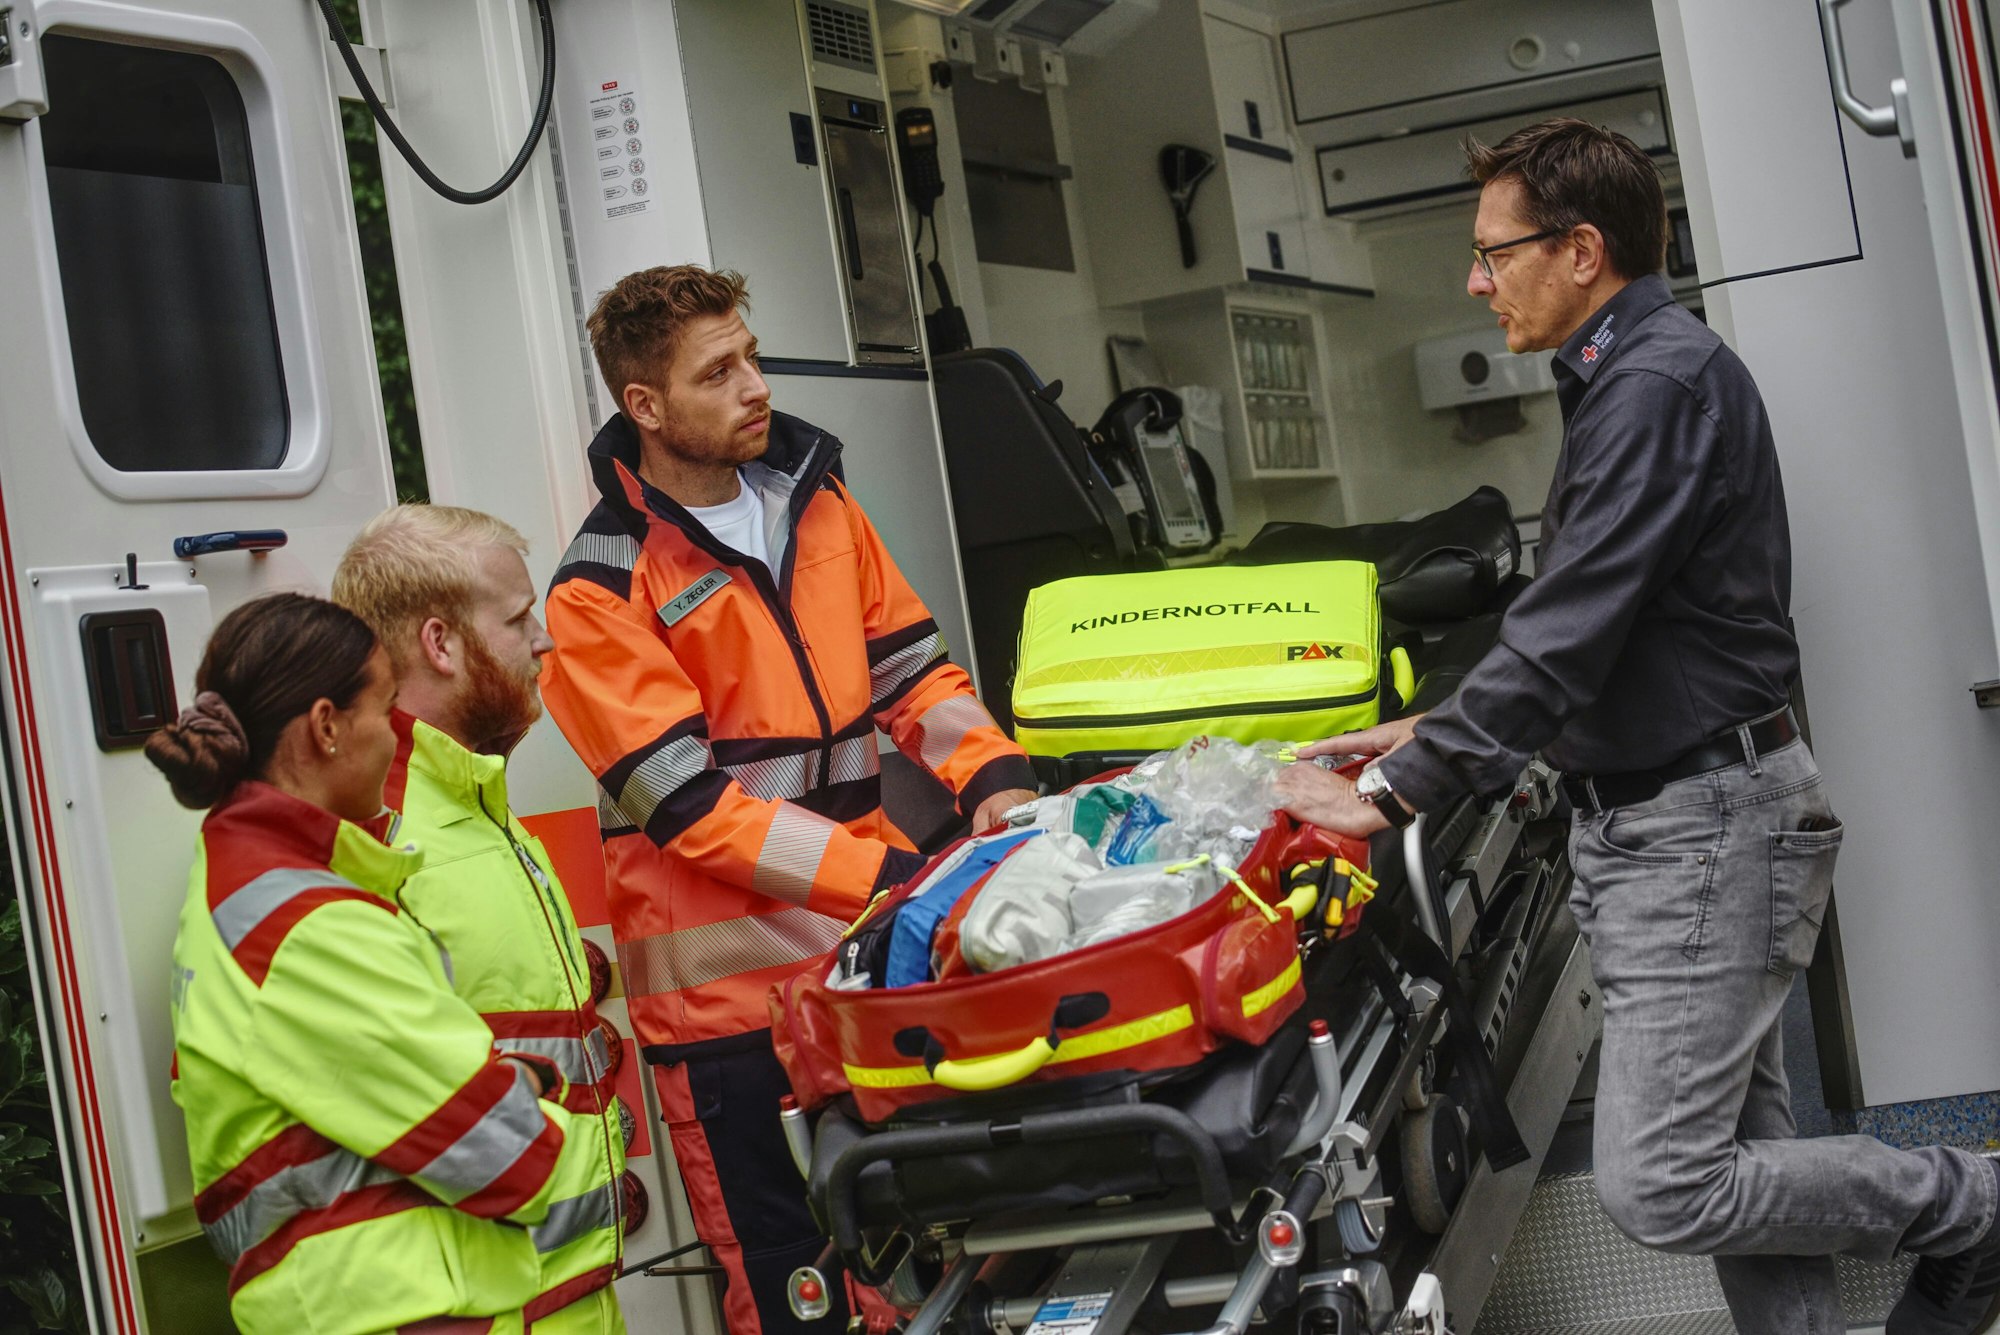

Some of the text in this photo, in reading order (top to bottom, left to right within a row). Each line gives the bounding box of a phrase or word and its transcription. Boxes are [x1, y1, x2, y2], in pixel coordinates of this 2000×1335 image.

[1591, 314, 1614, 342] Deutsches
[674, 578, 717, 611] Y. ZIEGLER
[1071, 602, 1320, 633] KINDERNOTFALL
[1287, 642, 1344, 661] PAX
